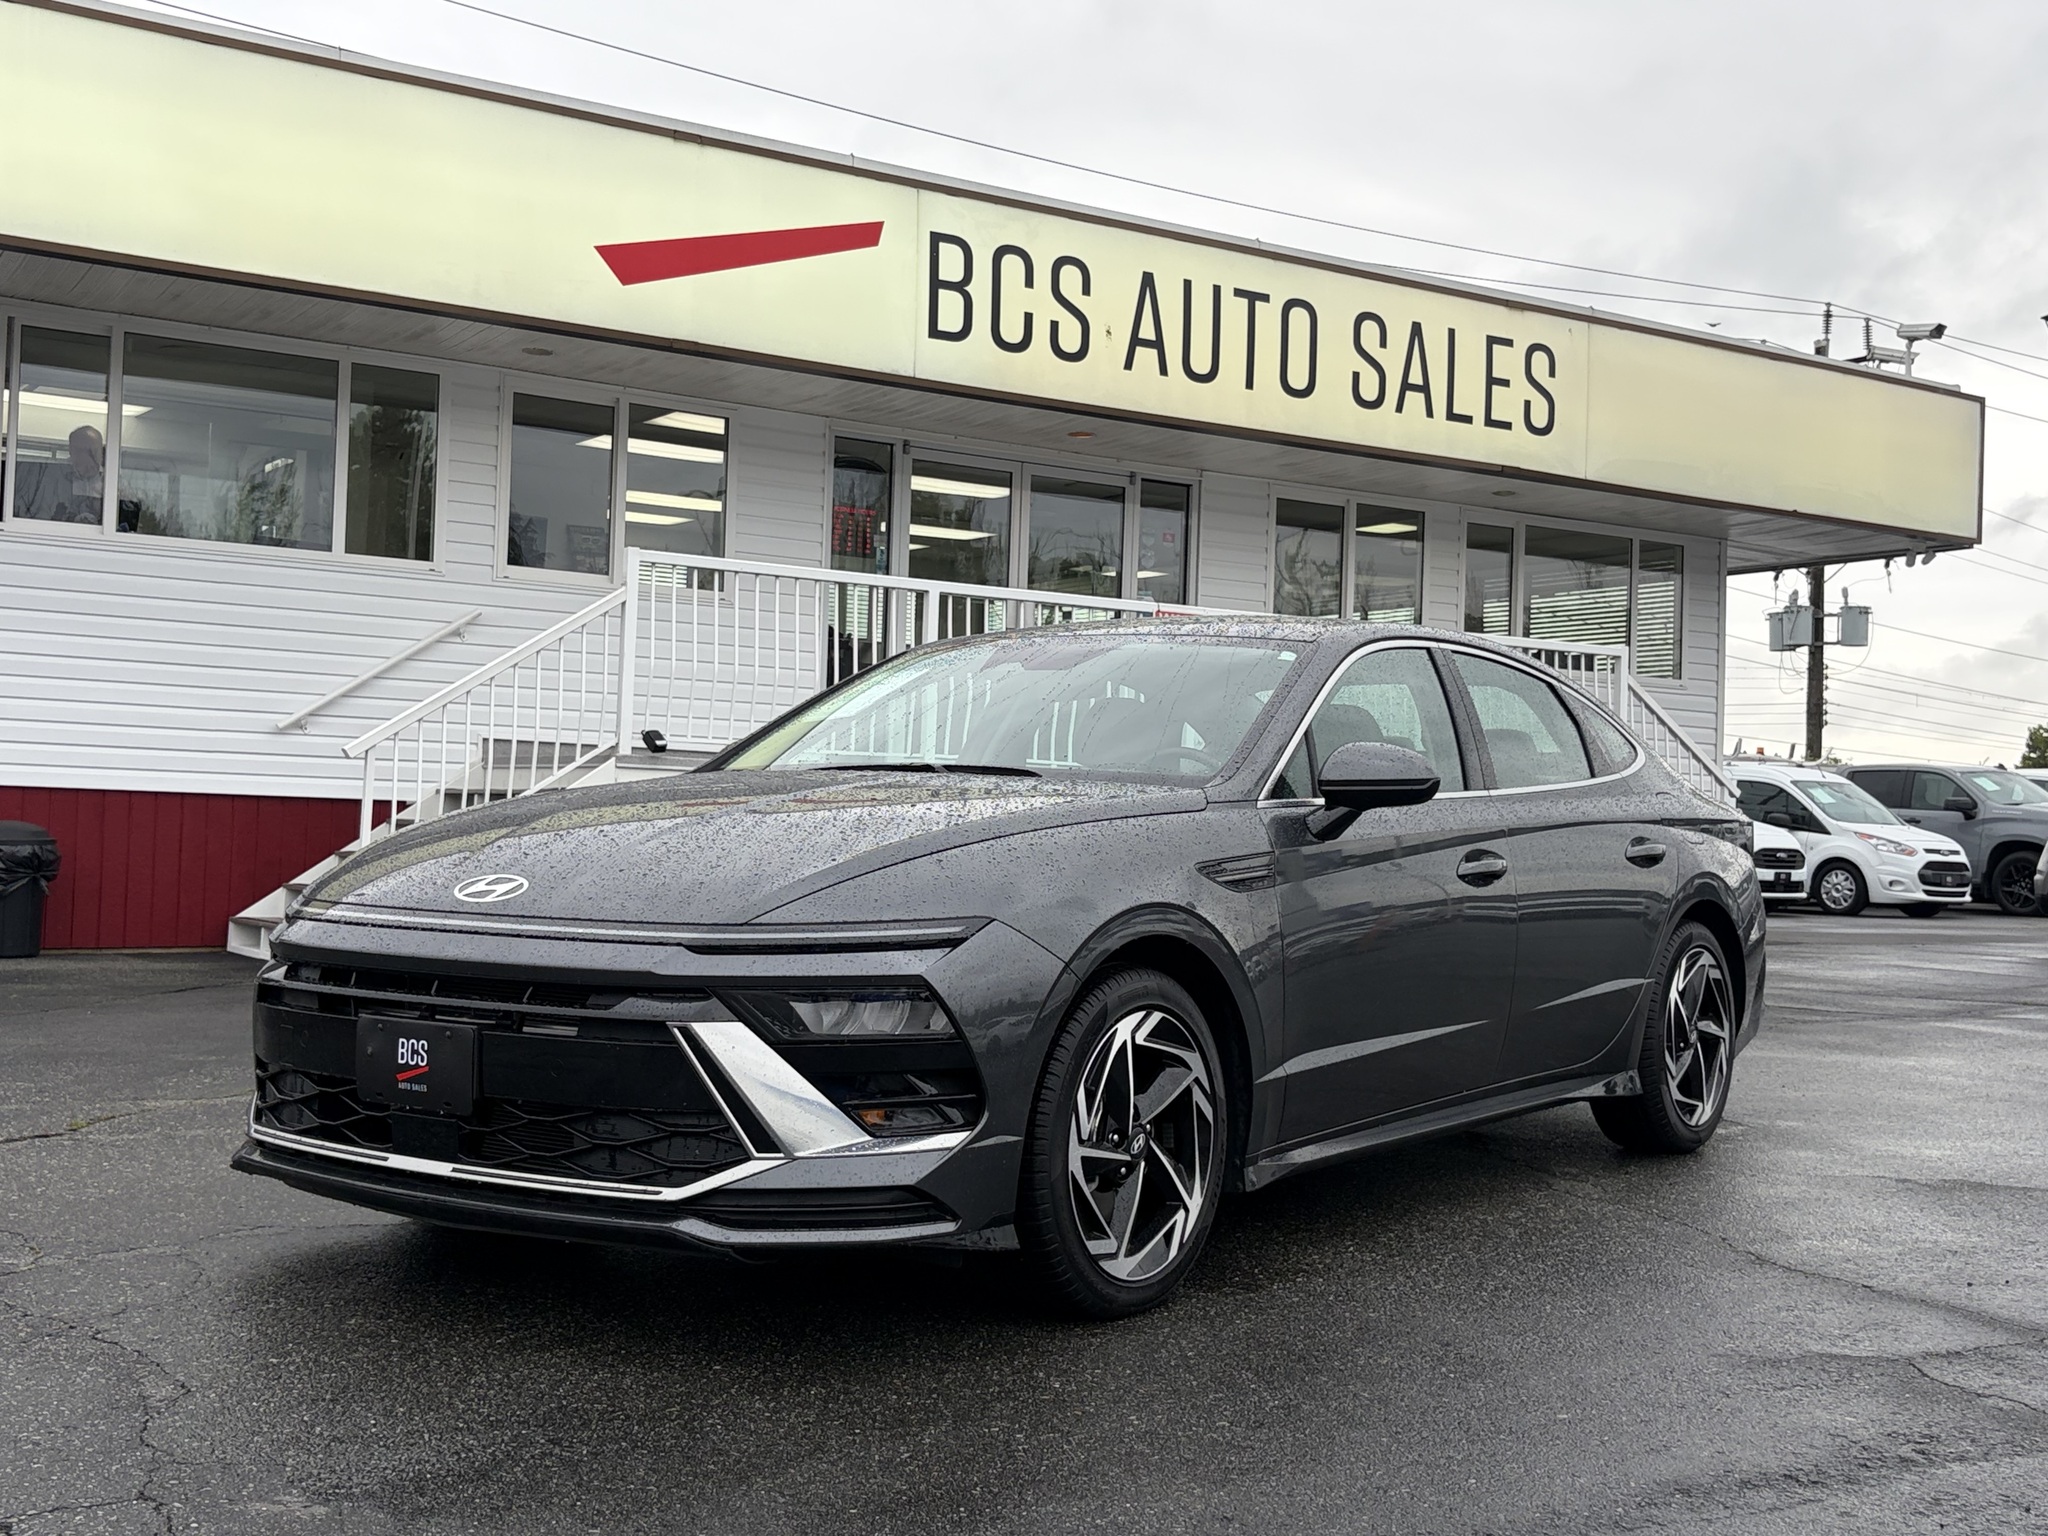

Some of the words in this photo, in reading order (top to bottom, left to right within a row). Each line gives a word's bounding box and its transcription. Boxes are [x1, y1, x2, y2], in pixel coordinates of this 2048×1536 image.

[928, 230, 1092, 363] BCS
[1123, 270, 1318, 399] AUTO
[1351, 310, 1556, 437] SALES
[397, 1037, 428, 1067] BCS
